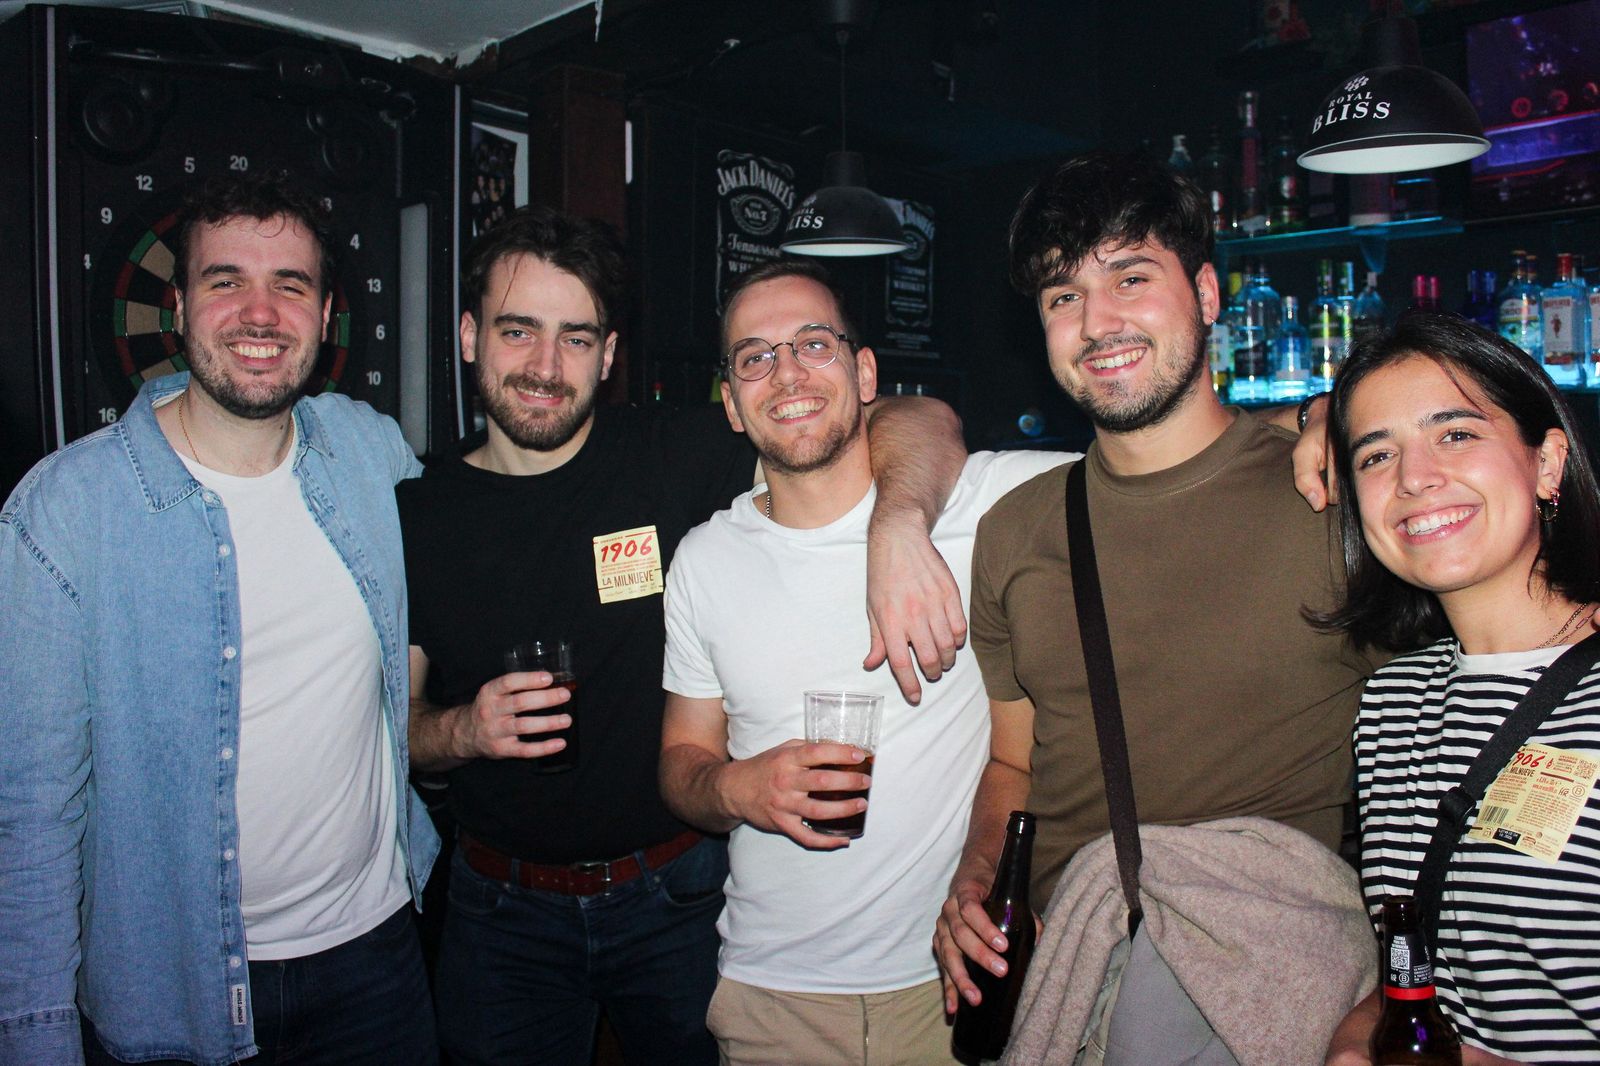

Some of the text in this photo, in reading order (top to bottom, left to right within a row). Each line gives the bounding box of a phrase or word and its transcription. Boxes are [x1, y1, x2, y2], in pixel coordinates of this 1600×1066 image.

[1328, 91, 1373, 108] ROYAL
[1311, 101, 1391, 135] BLISS
[184, 156, 196, 174] 5
[229, 154, 249, 172] 20
[135, 174, 153, 192] 12
[717, 159, 797, 210] JACK DANIEL'S
[100, 207, 113, 225] 9
[349, 233, 360, 250] 4
[366, 278, 382, 293] 13
[375, 324, 386, 340] 6
[366, 371, 382, 386] 10
[98, 407, 117, 424] 16
[601, 535, 653, 563] 1906
[602, 570, 655, 588] LA MILNUEVE
[1512, 751, 1546, 769] 906
